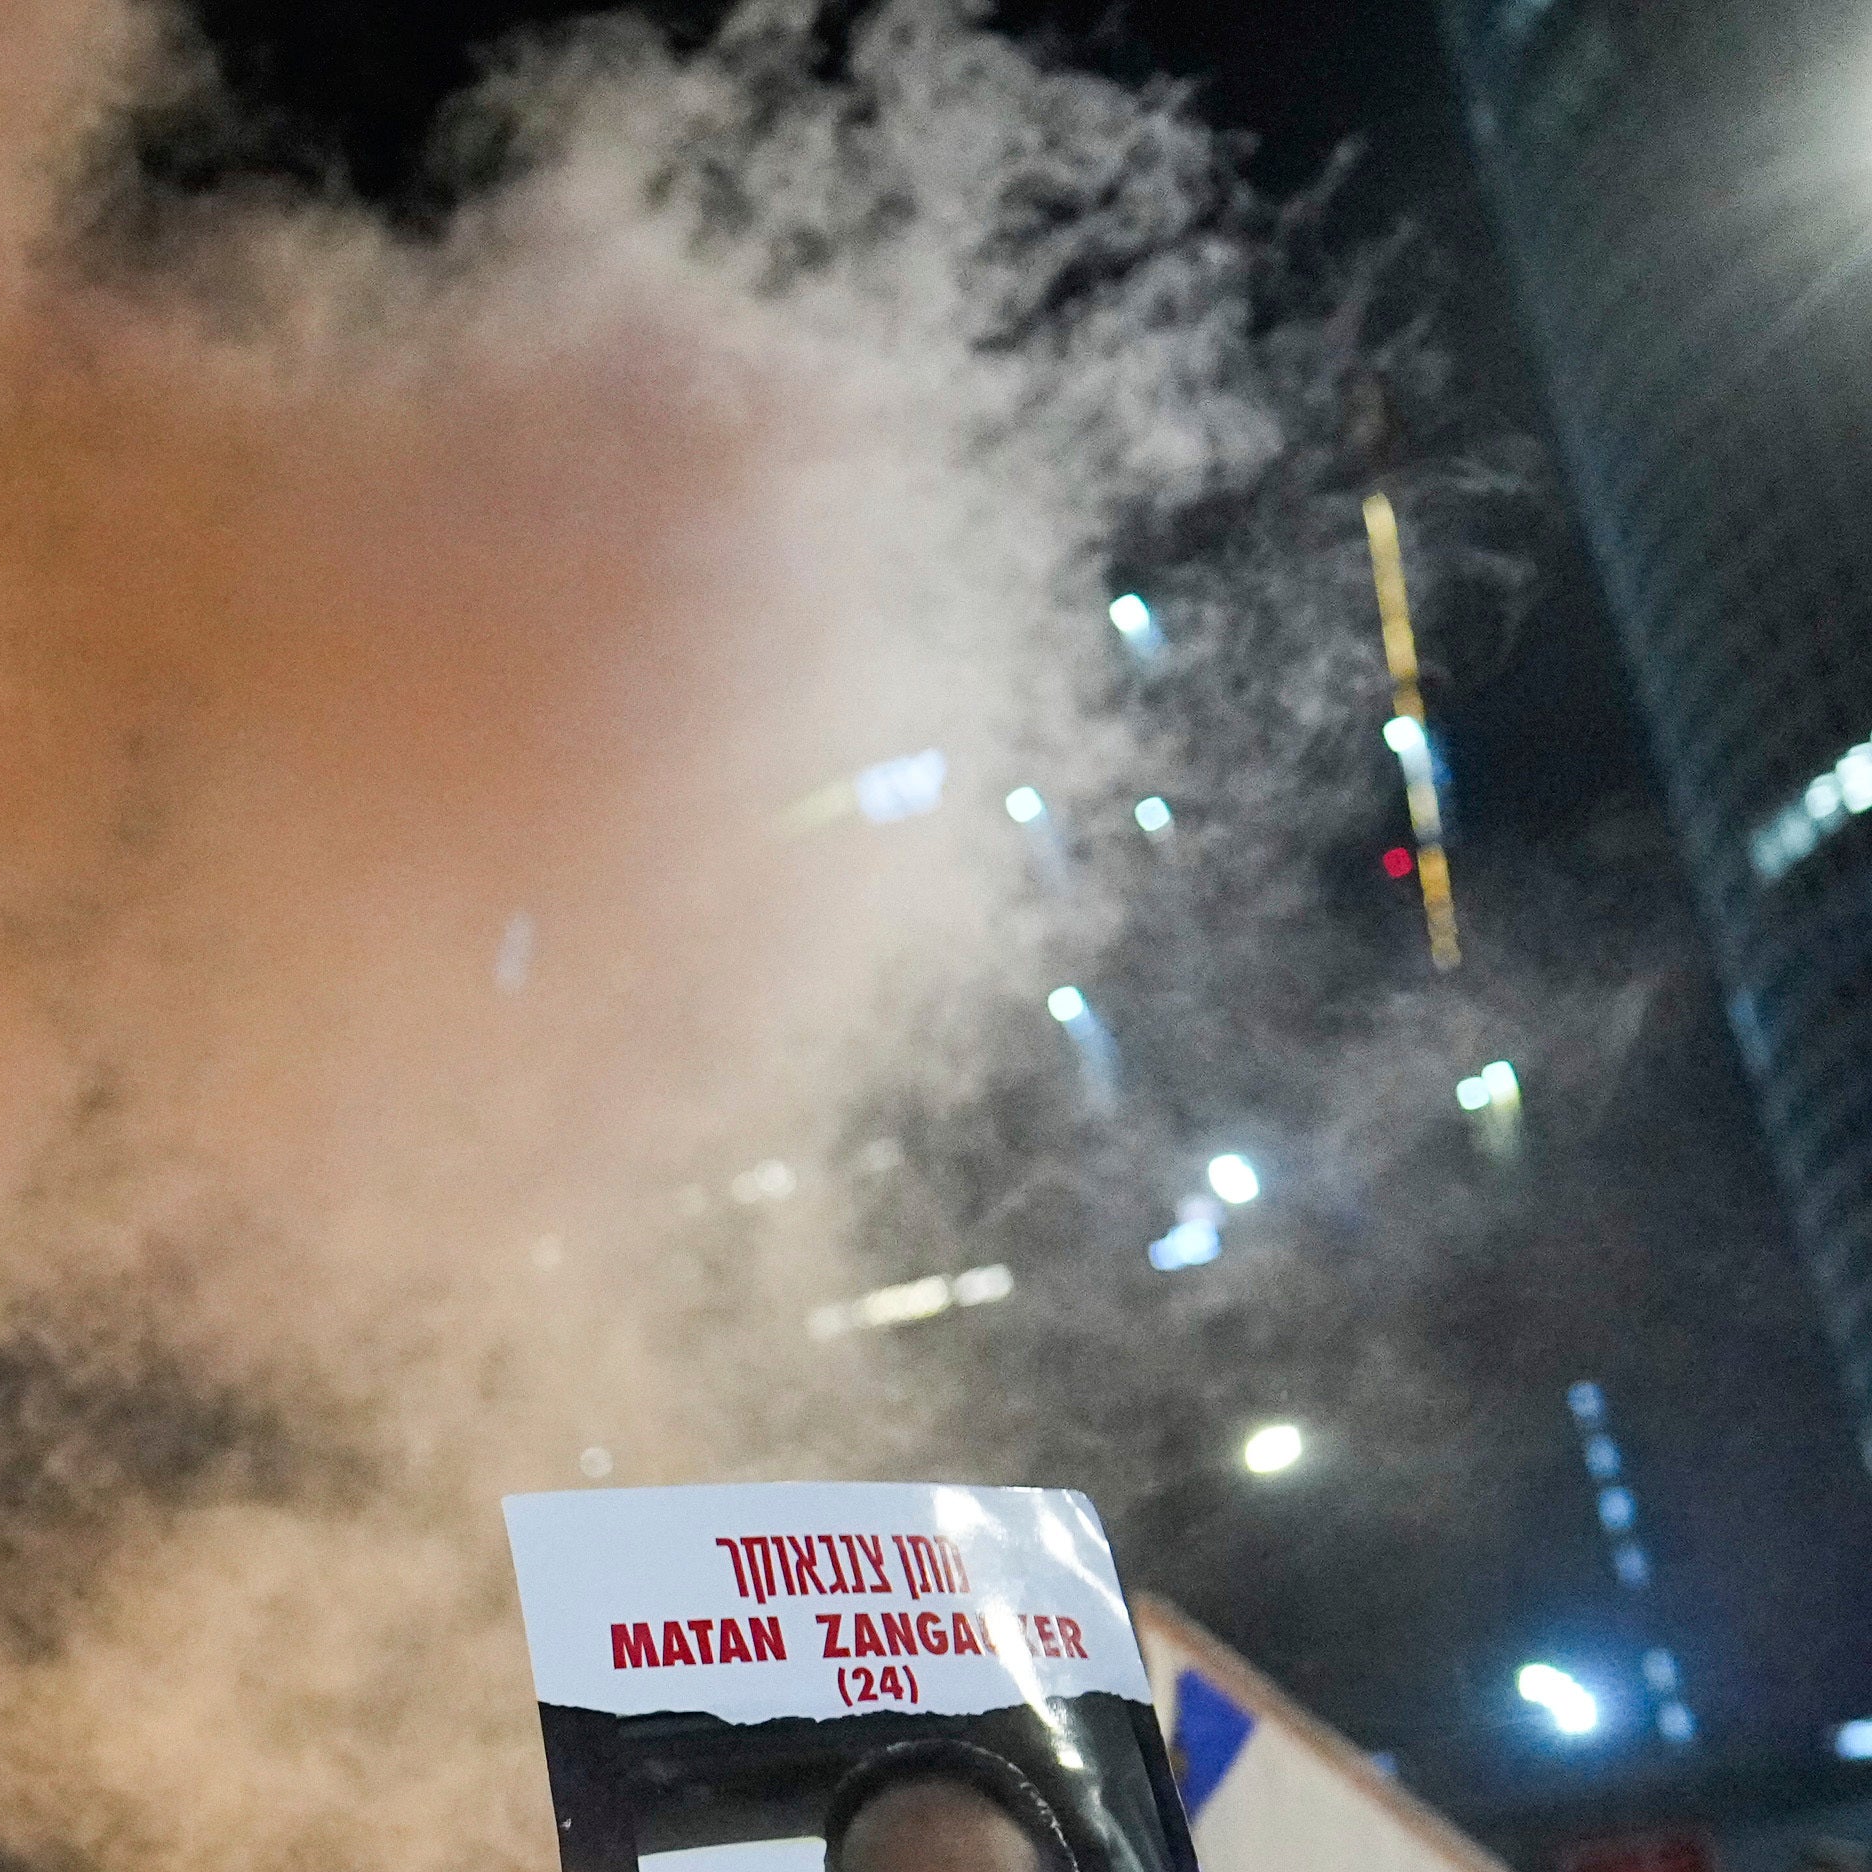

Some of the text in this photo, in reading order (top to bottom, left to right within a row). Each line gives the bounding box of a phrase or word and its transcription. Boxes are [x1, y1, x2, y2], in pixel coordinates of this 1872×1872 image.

[716, 1534, 970, 1604] מתן צנגאוקר
[610, 1615, 787, 1670] MATAN
[837, 1665, 919, 1707] (24)
